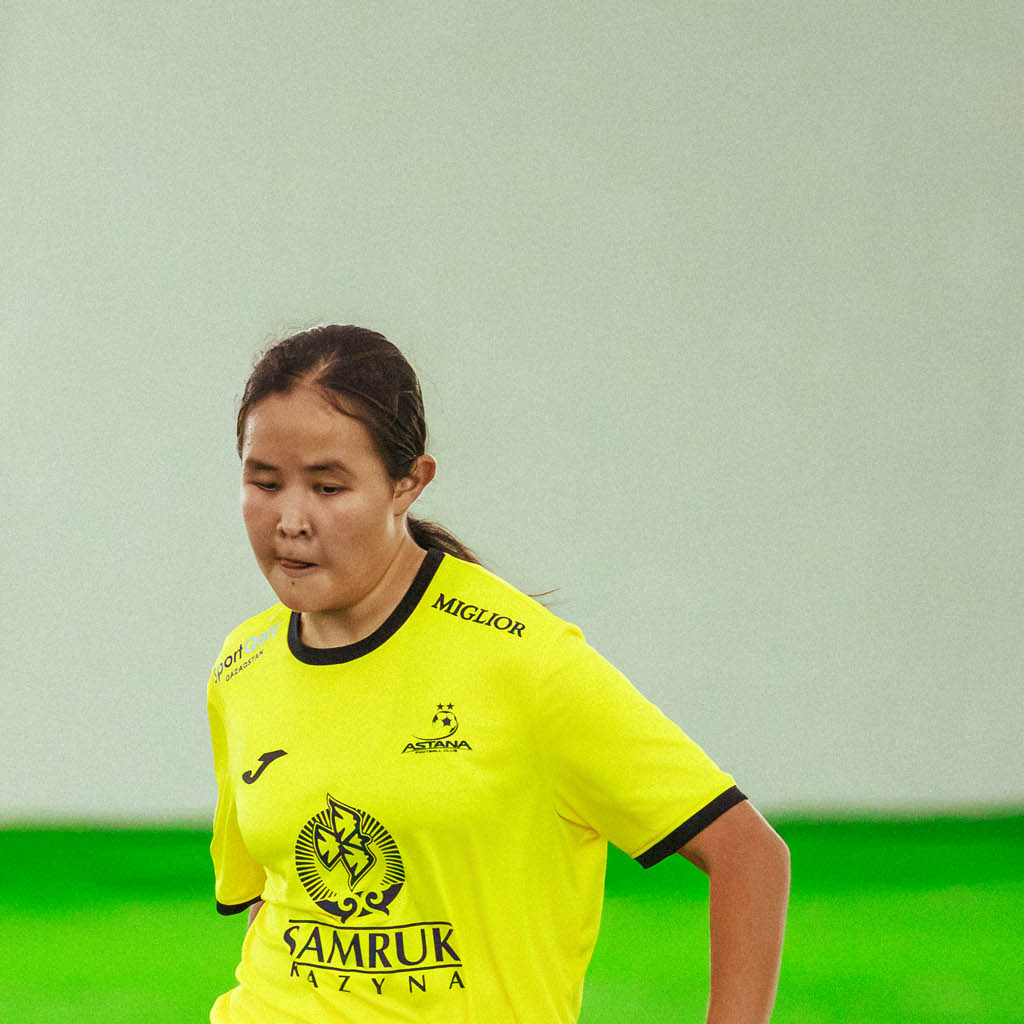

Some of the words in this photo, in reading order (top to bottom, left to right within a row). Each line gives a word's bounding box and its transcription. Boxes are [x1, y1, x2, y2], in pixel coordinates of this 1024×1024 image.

[431, 592, 526, 638] MIGLIOR
[401, 740, 472, 753] ASTANA
[283, 925, 461, 968] SAMRUK
[291, 963, 465, 995] KAZYNA
